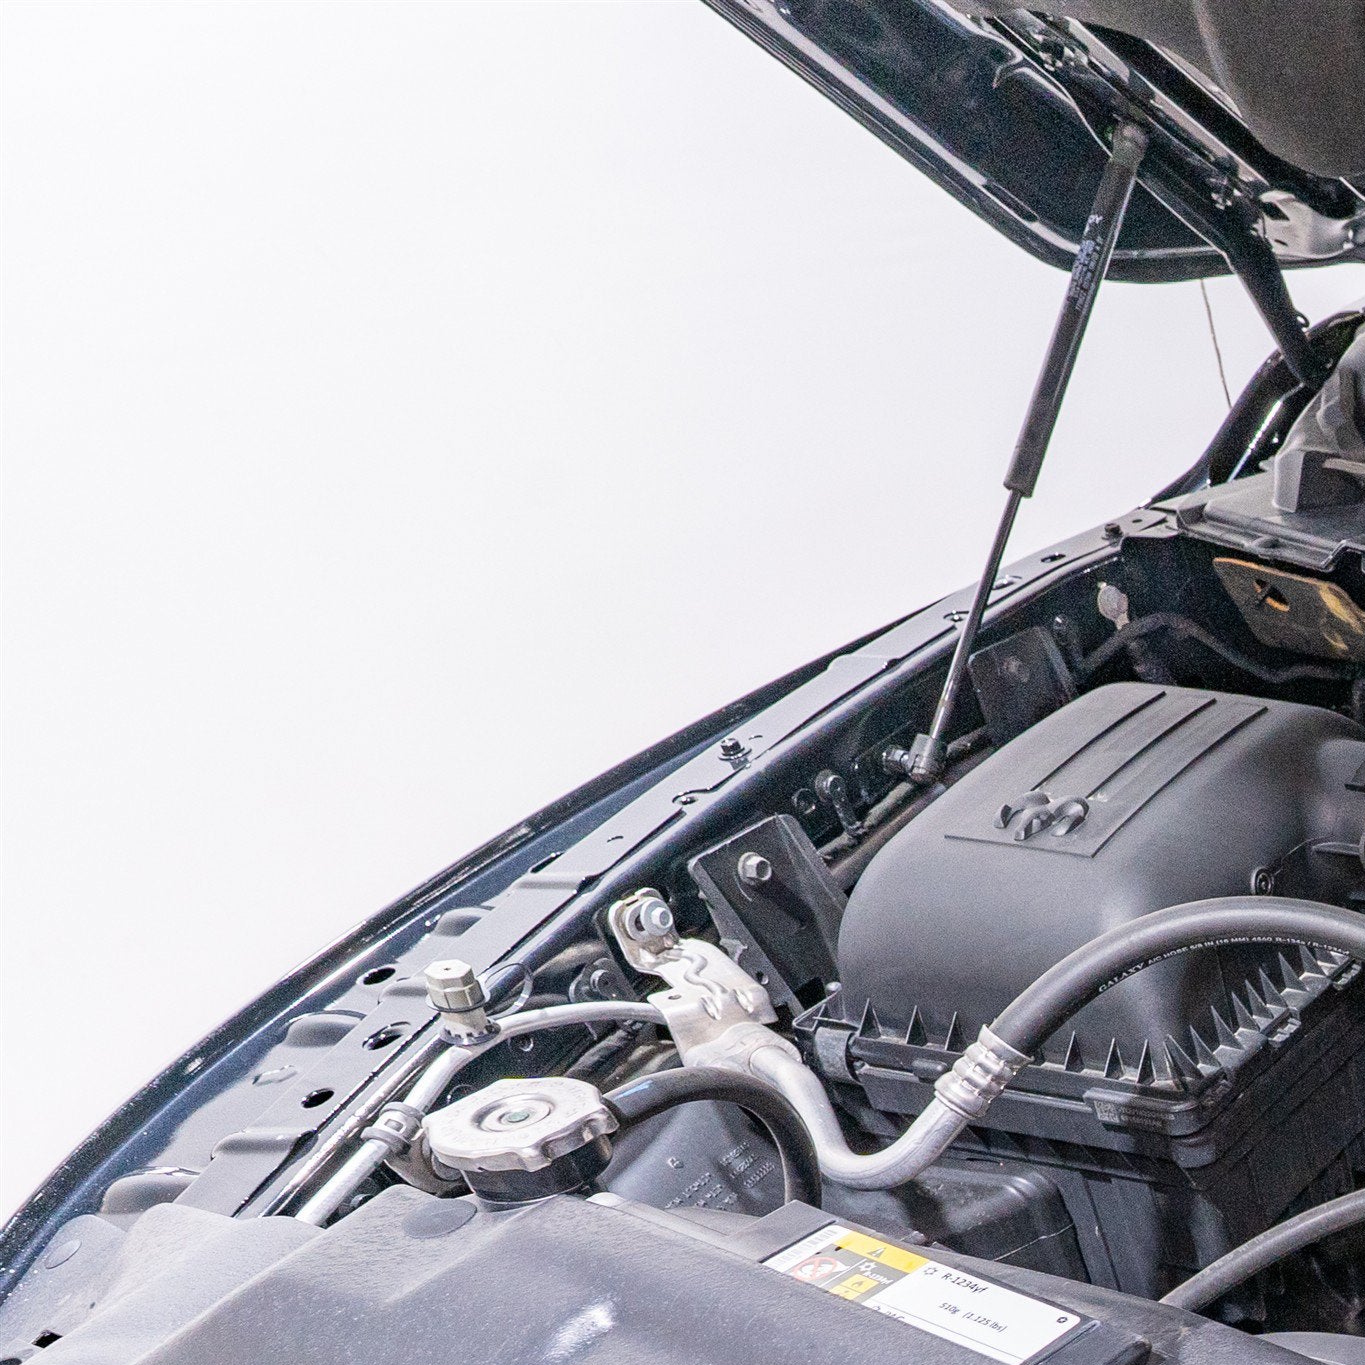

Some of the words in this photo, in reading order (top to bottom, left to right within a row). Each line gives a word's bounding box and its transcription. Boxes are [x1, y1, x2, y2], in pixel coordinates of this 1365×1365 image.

[1098, 962, 1145, 993] GALAXY
[941, 1273, 989, 1294] R-1234yf
[938, 1302, 960, 1315] 510g
